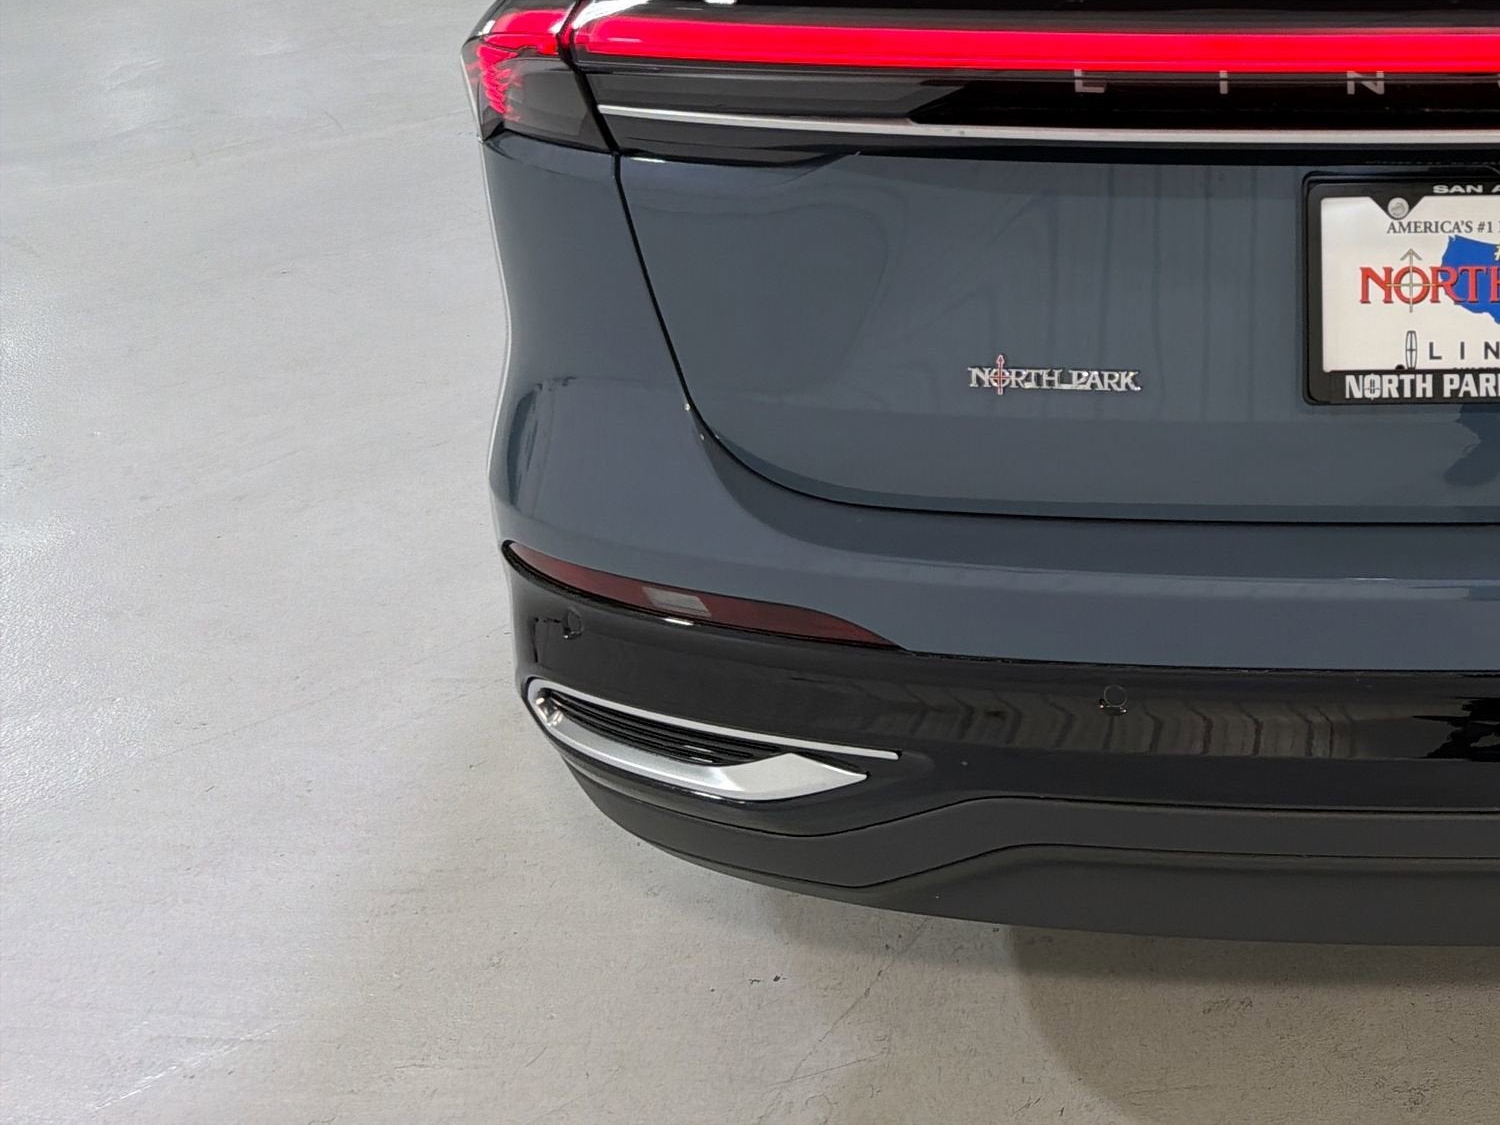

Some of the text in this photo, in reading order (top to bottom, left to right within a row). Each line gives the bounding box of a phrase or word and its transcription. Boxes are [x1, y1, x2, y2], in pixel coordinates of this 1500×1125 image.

[1433, 184, 1483, 193] SAN
[1386, 220, 1473, 234] AMERICA'S
[1477, 220, 1493, 234] #1
[967, 366, 1142, 392] NORTH PARK
[1344, 373, 1434, 400] NORTH
